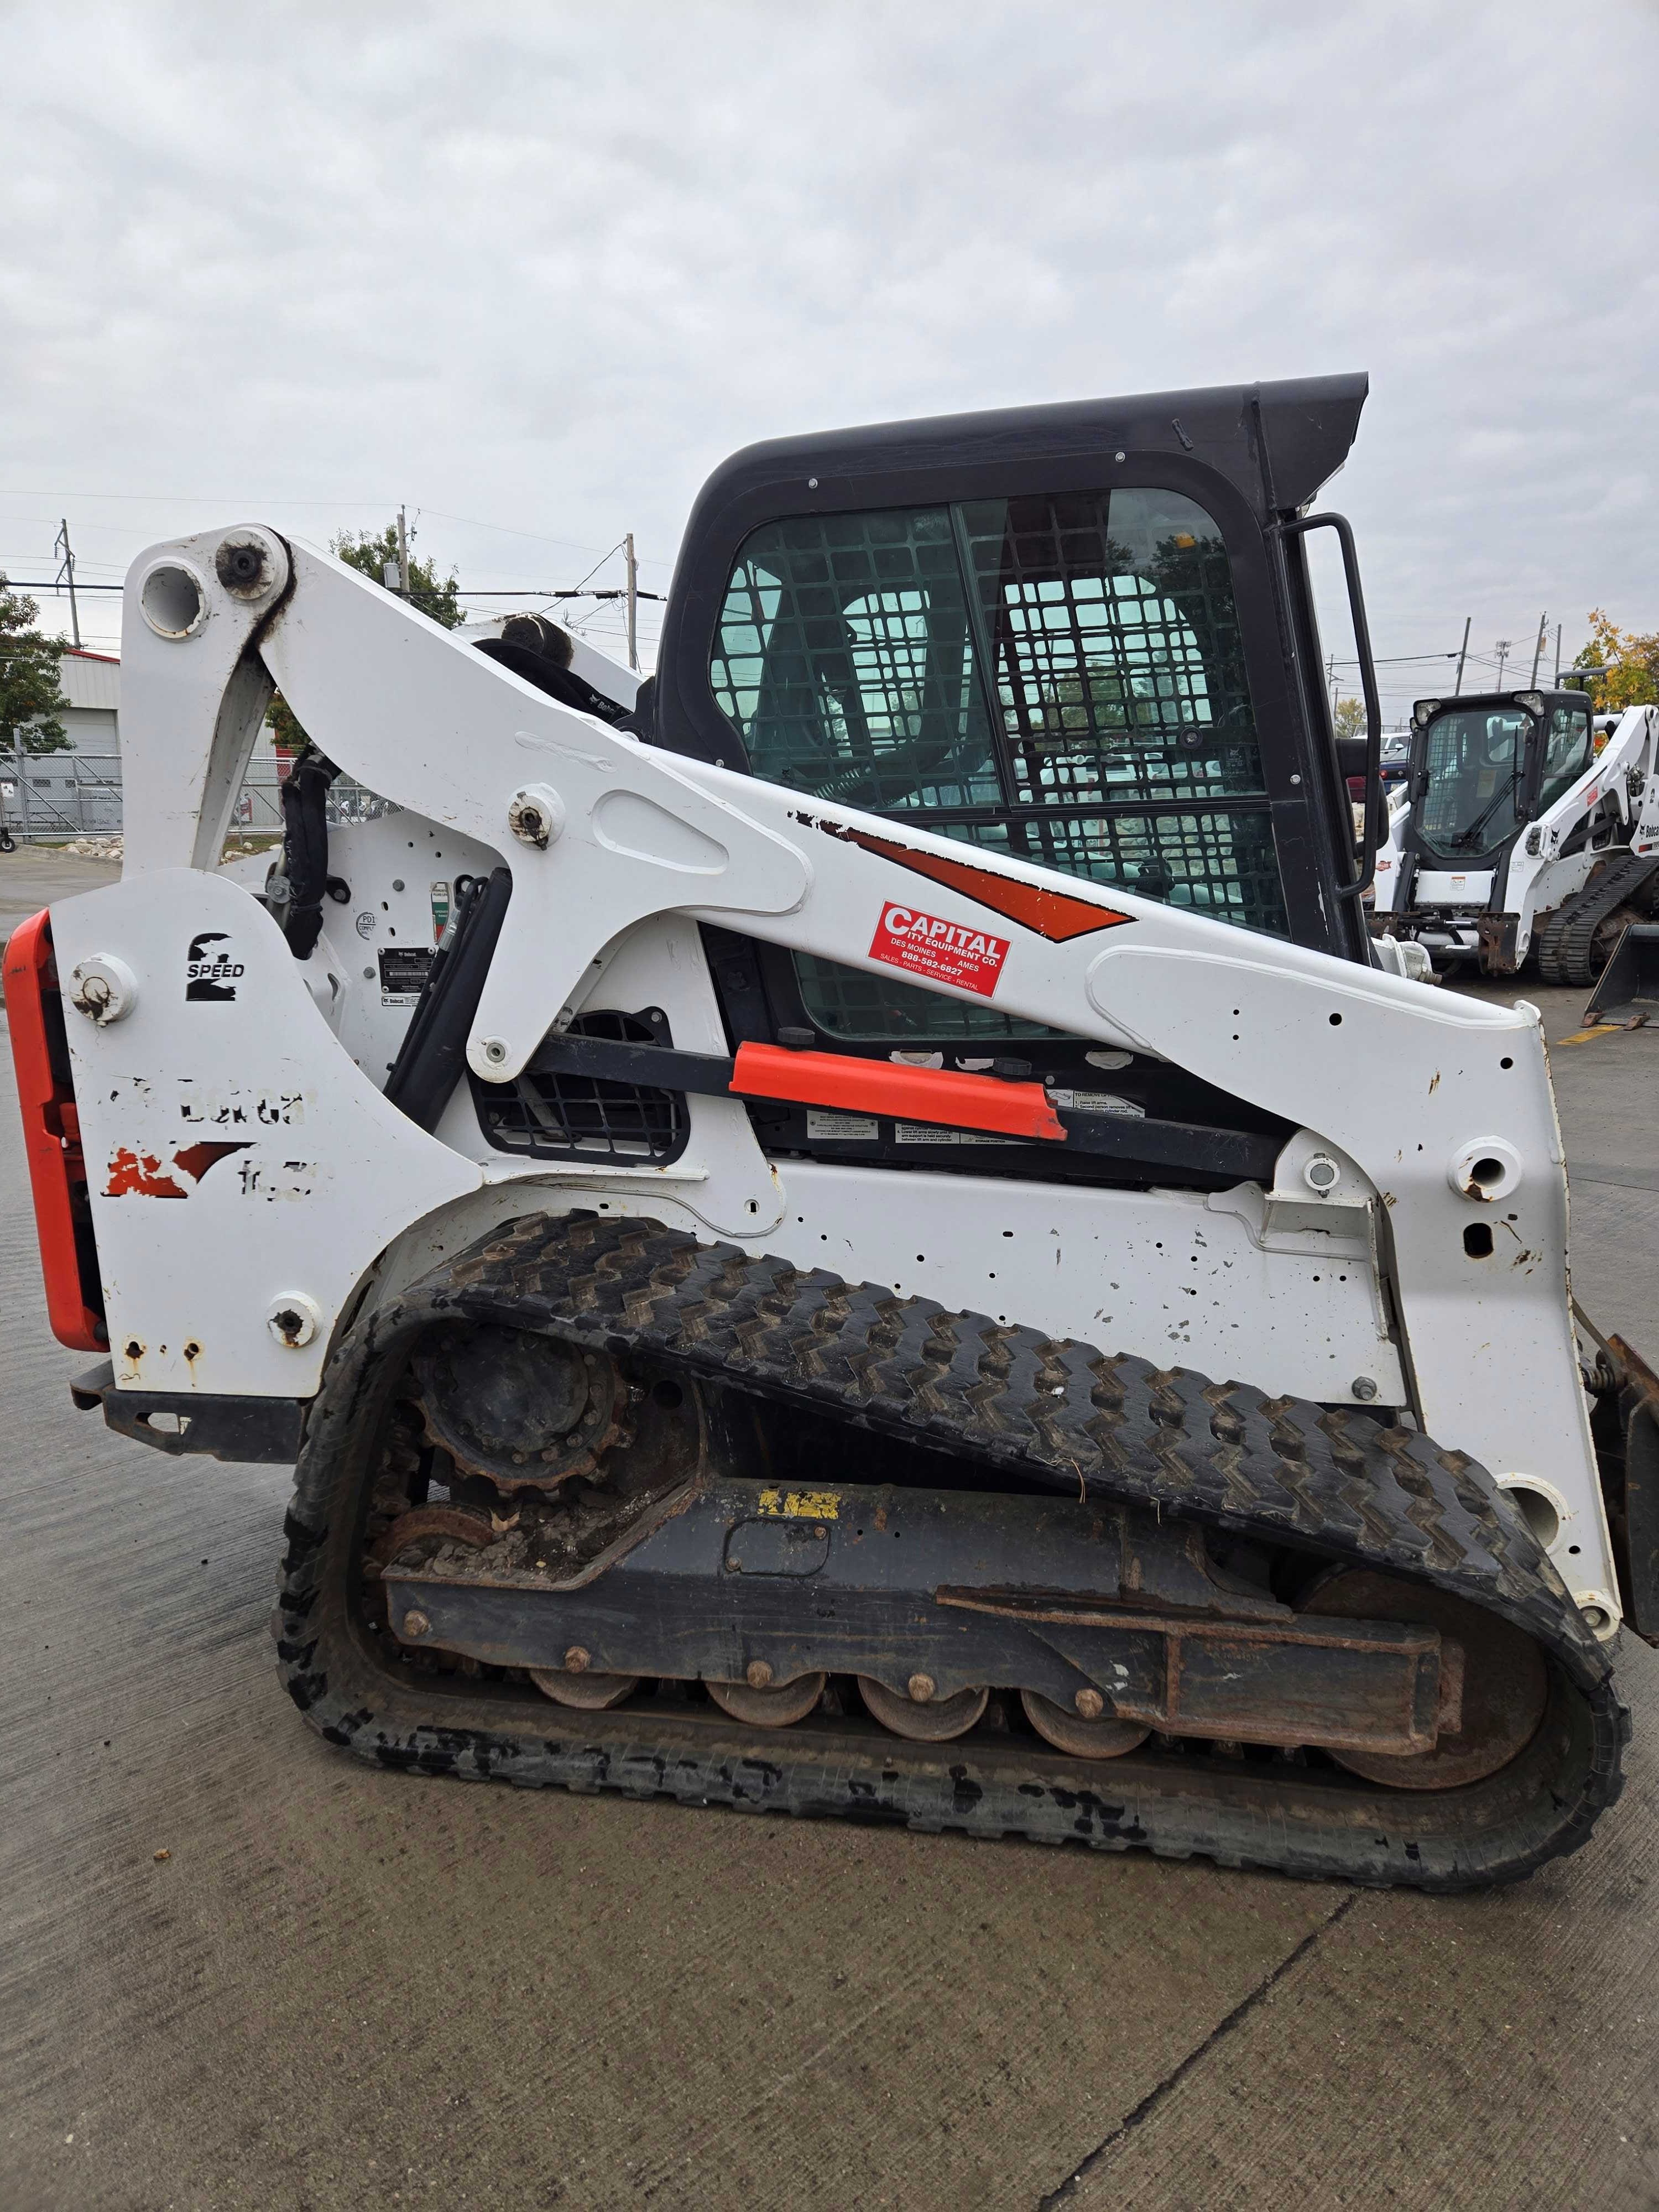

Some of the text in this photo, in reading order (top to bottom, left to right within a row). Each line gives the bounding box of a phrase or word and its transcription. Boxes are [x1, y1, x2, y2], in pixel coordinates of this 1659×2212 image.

[1646, 825, 1659, 838] Bobca
[885, 907, 1000, 959] CAPITAL
[907, 932, 997, 967] ITY EQUIPMENT CO.
[187, 964, 244, 978] SPEED
[880, 953, 978, 990] SALES PARTS SERVICE RENTAL
[891, 938, 979, 972] DES MOINES AMES
[901, 951, 963, 976] 888-582-6827
